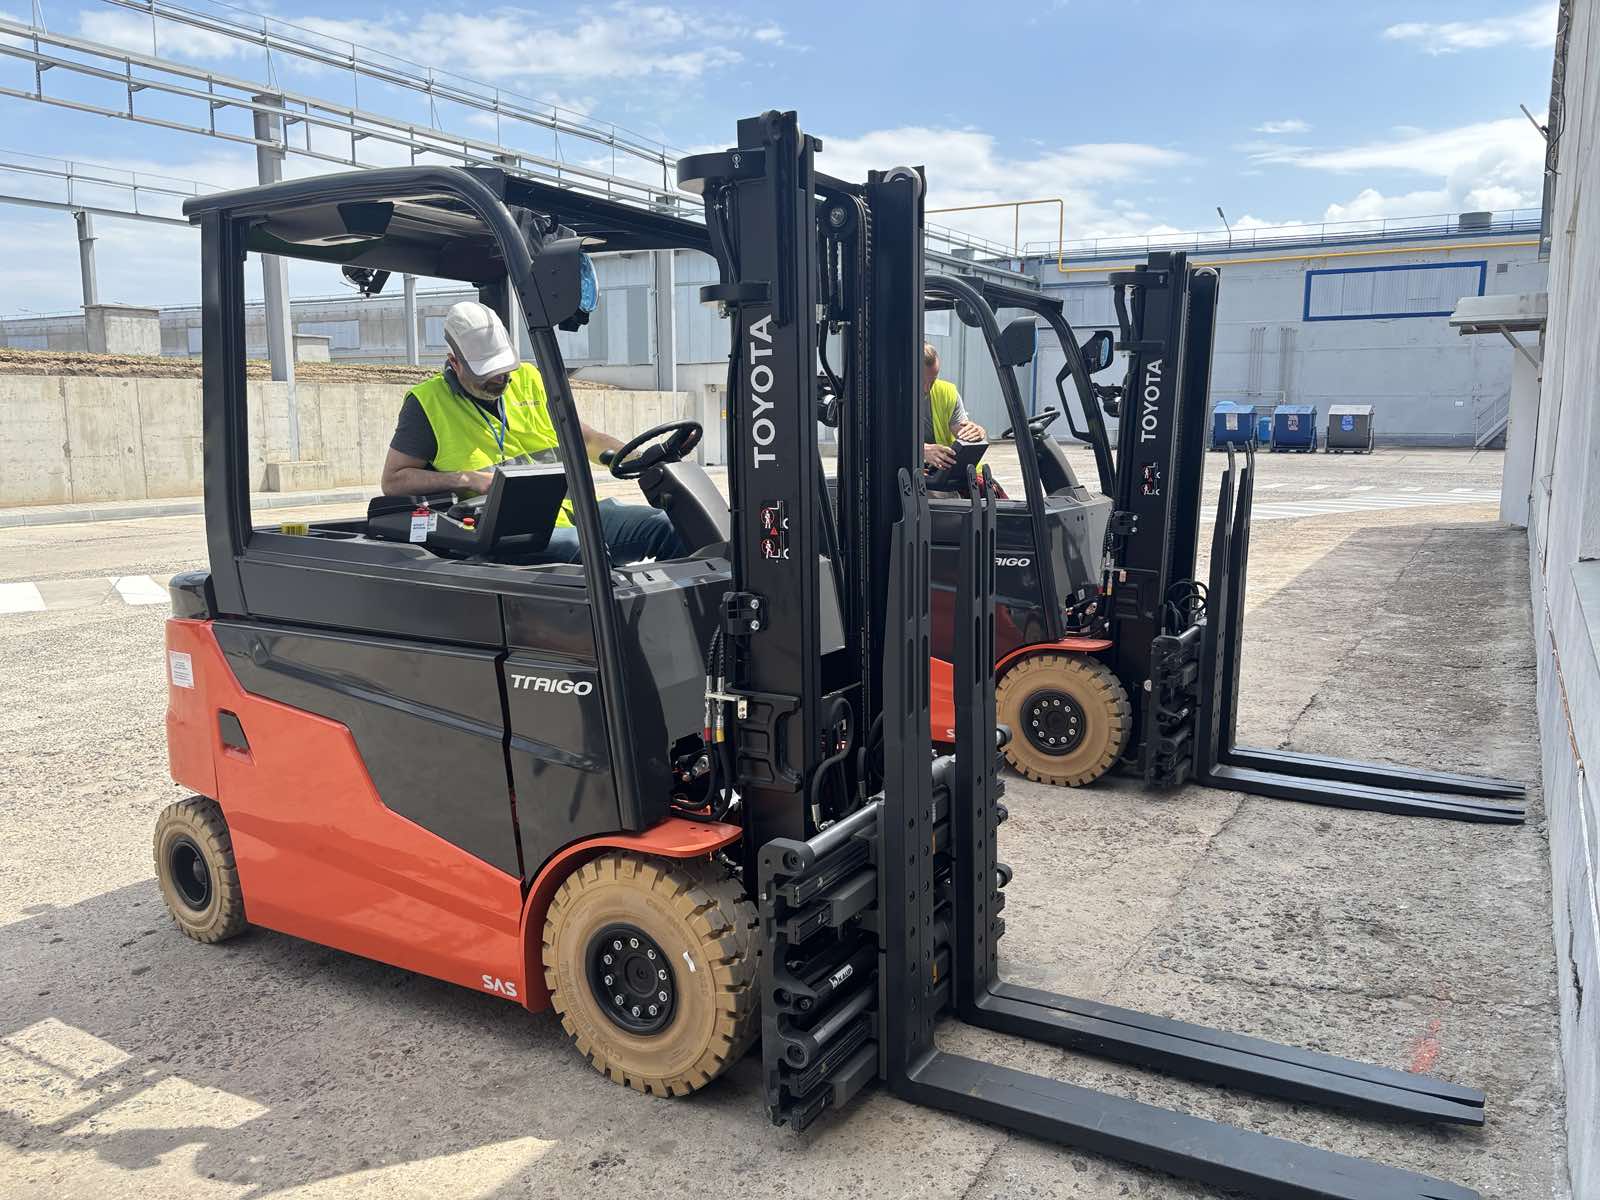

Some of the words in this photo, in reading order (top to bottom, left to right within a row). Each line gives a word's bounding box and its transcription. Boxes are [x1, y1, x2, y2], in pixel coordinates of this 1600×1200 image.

[750, 314, 776, 469] TOYOTA
[1141, 359, 1162, 443] TOYOTA
[994, 557, 1031, 567] AIGO
[482, 974, 517, 997] SAS
